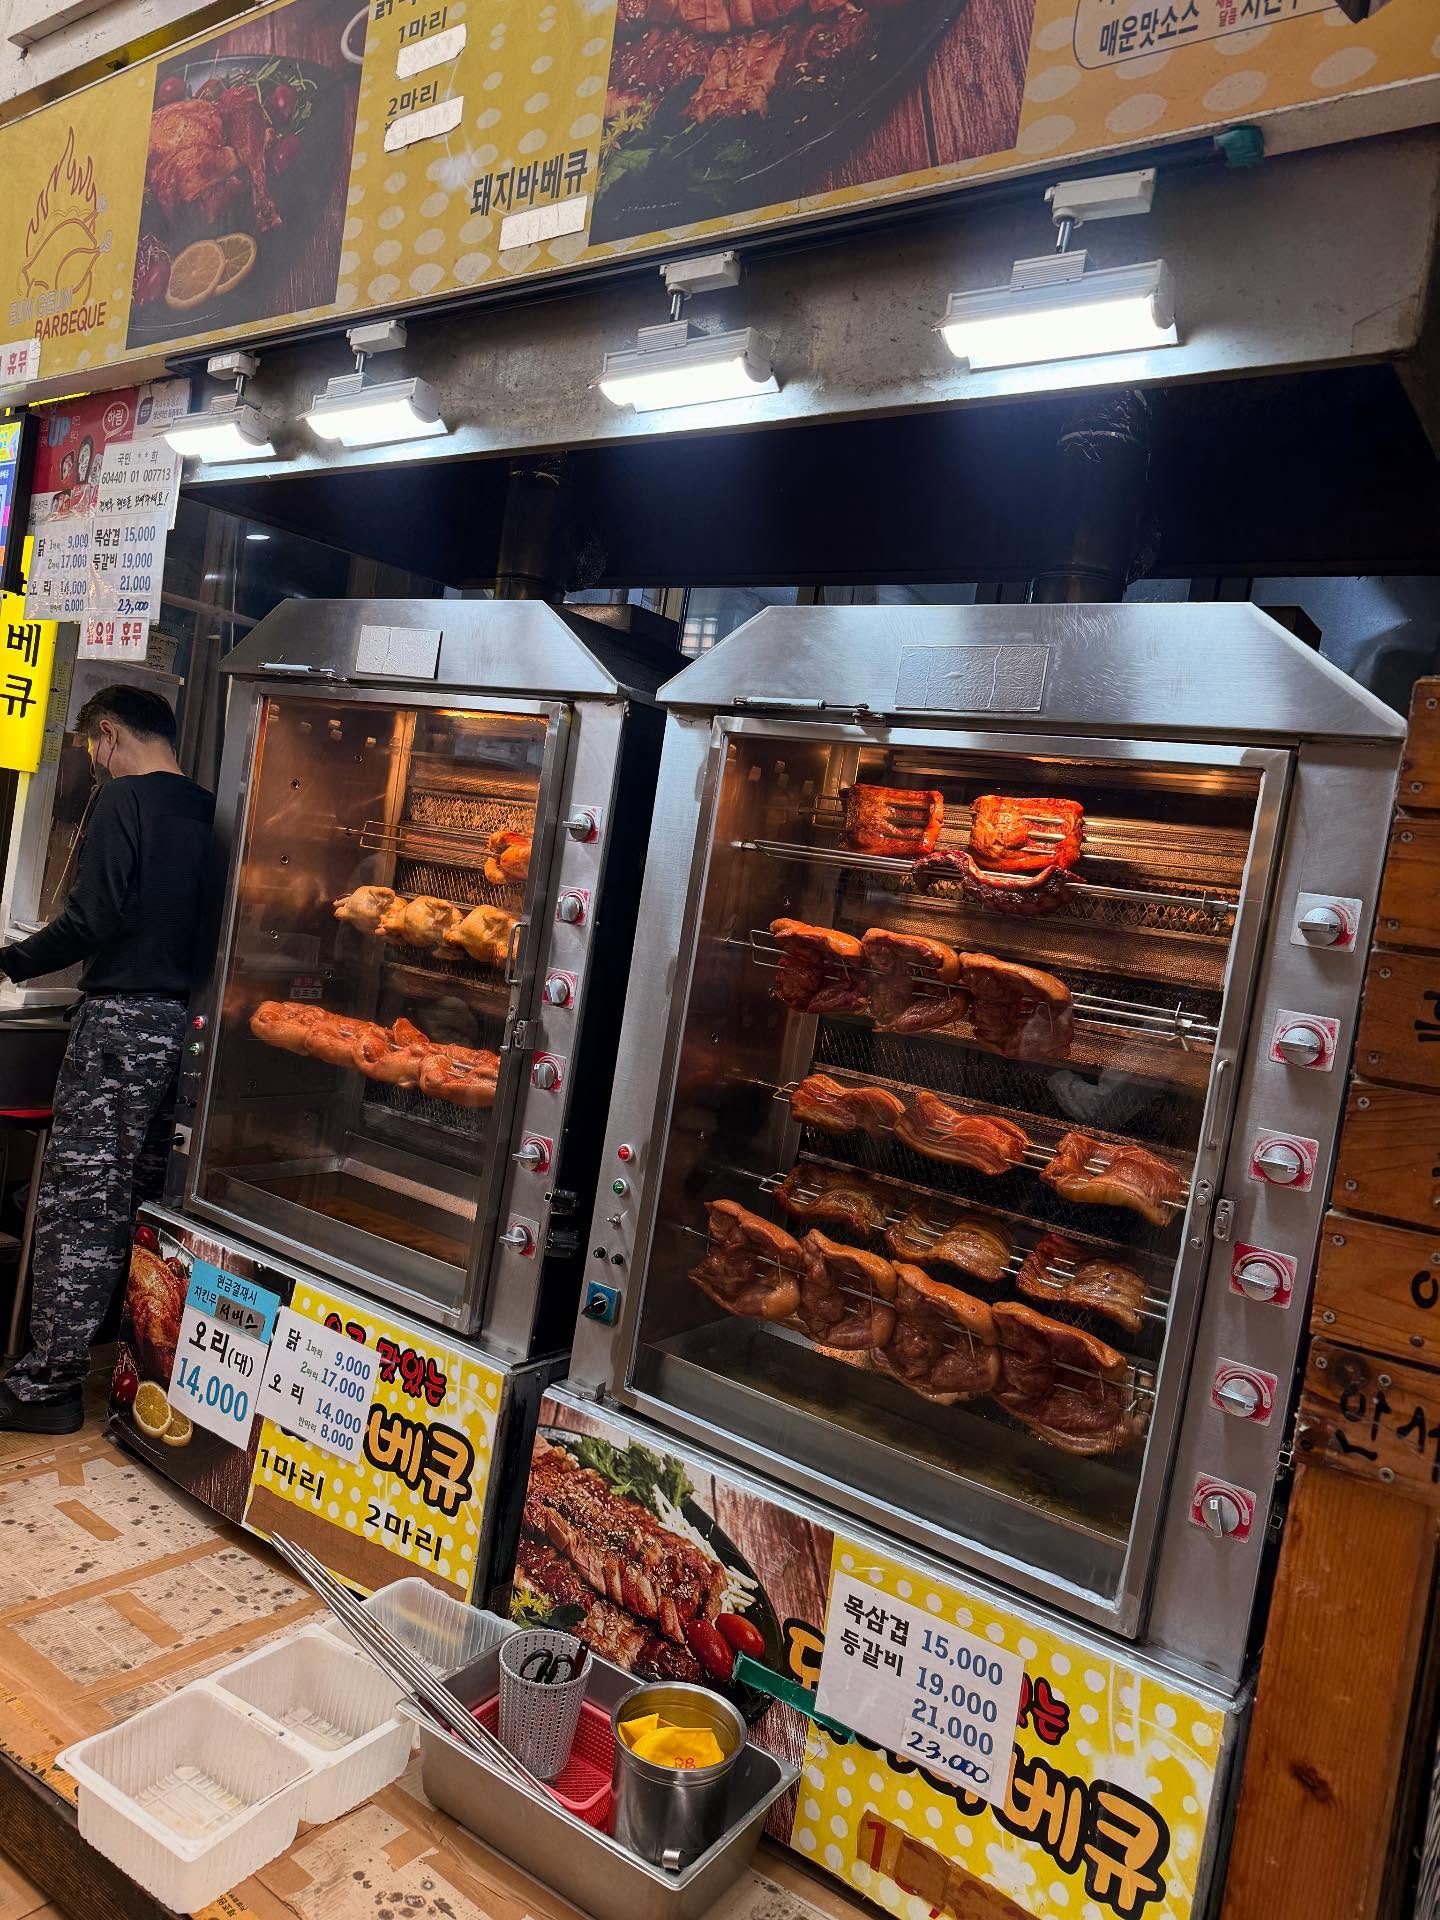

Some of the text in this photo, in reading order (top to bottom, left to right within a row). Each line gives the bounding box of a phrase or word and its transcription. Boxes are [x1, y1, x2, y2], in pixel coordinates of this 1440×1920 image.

[399, 7, 447, 43] 1마리
[1099, 6, 1199, 56] 매운맛소스
[387, 81, 438, 116] 2마리
[470, 148, 587, 216] 돼지바베큐
[35, 301, 107, 341] BARBEQUE
[7, 350, 27, 376] 휴무
[48, 415, 71, 447] UP
[107, 408, 124, 426] 하림
[130, 470, 140, 483] 01
[67, 533, 89, 548] 9,000
[94, 525, 156, 547] 목삼겹 15,000
[61, 553, 87, 570] 17,000
[93, 552, 153, 571] 등갈비 19,000
[119, 575, 150, 592] 21,000
[117, 598, 149, 614] 23,000
[120, 621, 143, 647] 휴무
[193, 1284, 217, 1308] 치킨무
[286, 1328, 301, 1352] 닭
[305, 1339, 323, 1359] 1마리
[334, 1351, 371, 1380] 9,000
[376, 1336, 447, 1407] 맛있는
[176, 1357, 249, 1422] 14,000
[300, 1361, 365, 1402] 2마리 17,000
[316, 1398, 362, 1433] 14,000
[320, 1424, 354, 1451] 8,000
[260, 1449, 324, 1500] 1마리
[363, 1403, 475, 1517] 베큐
[365, 1503, 443, 1562] 2마리
[843, 1593, 1003, 1686] 목삼겹 15,000
[840, 1627, 904, 1678] 등갈비
[915, 1665, 998, 1723] 19,000
[911, 1698, 994, 1756] 21,000
[906, 1730, 990, 1783] 23,000
[996, 1743, 1170, 1920] 베큐
